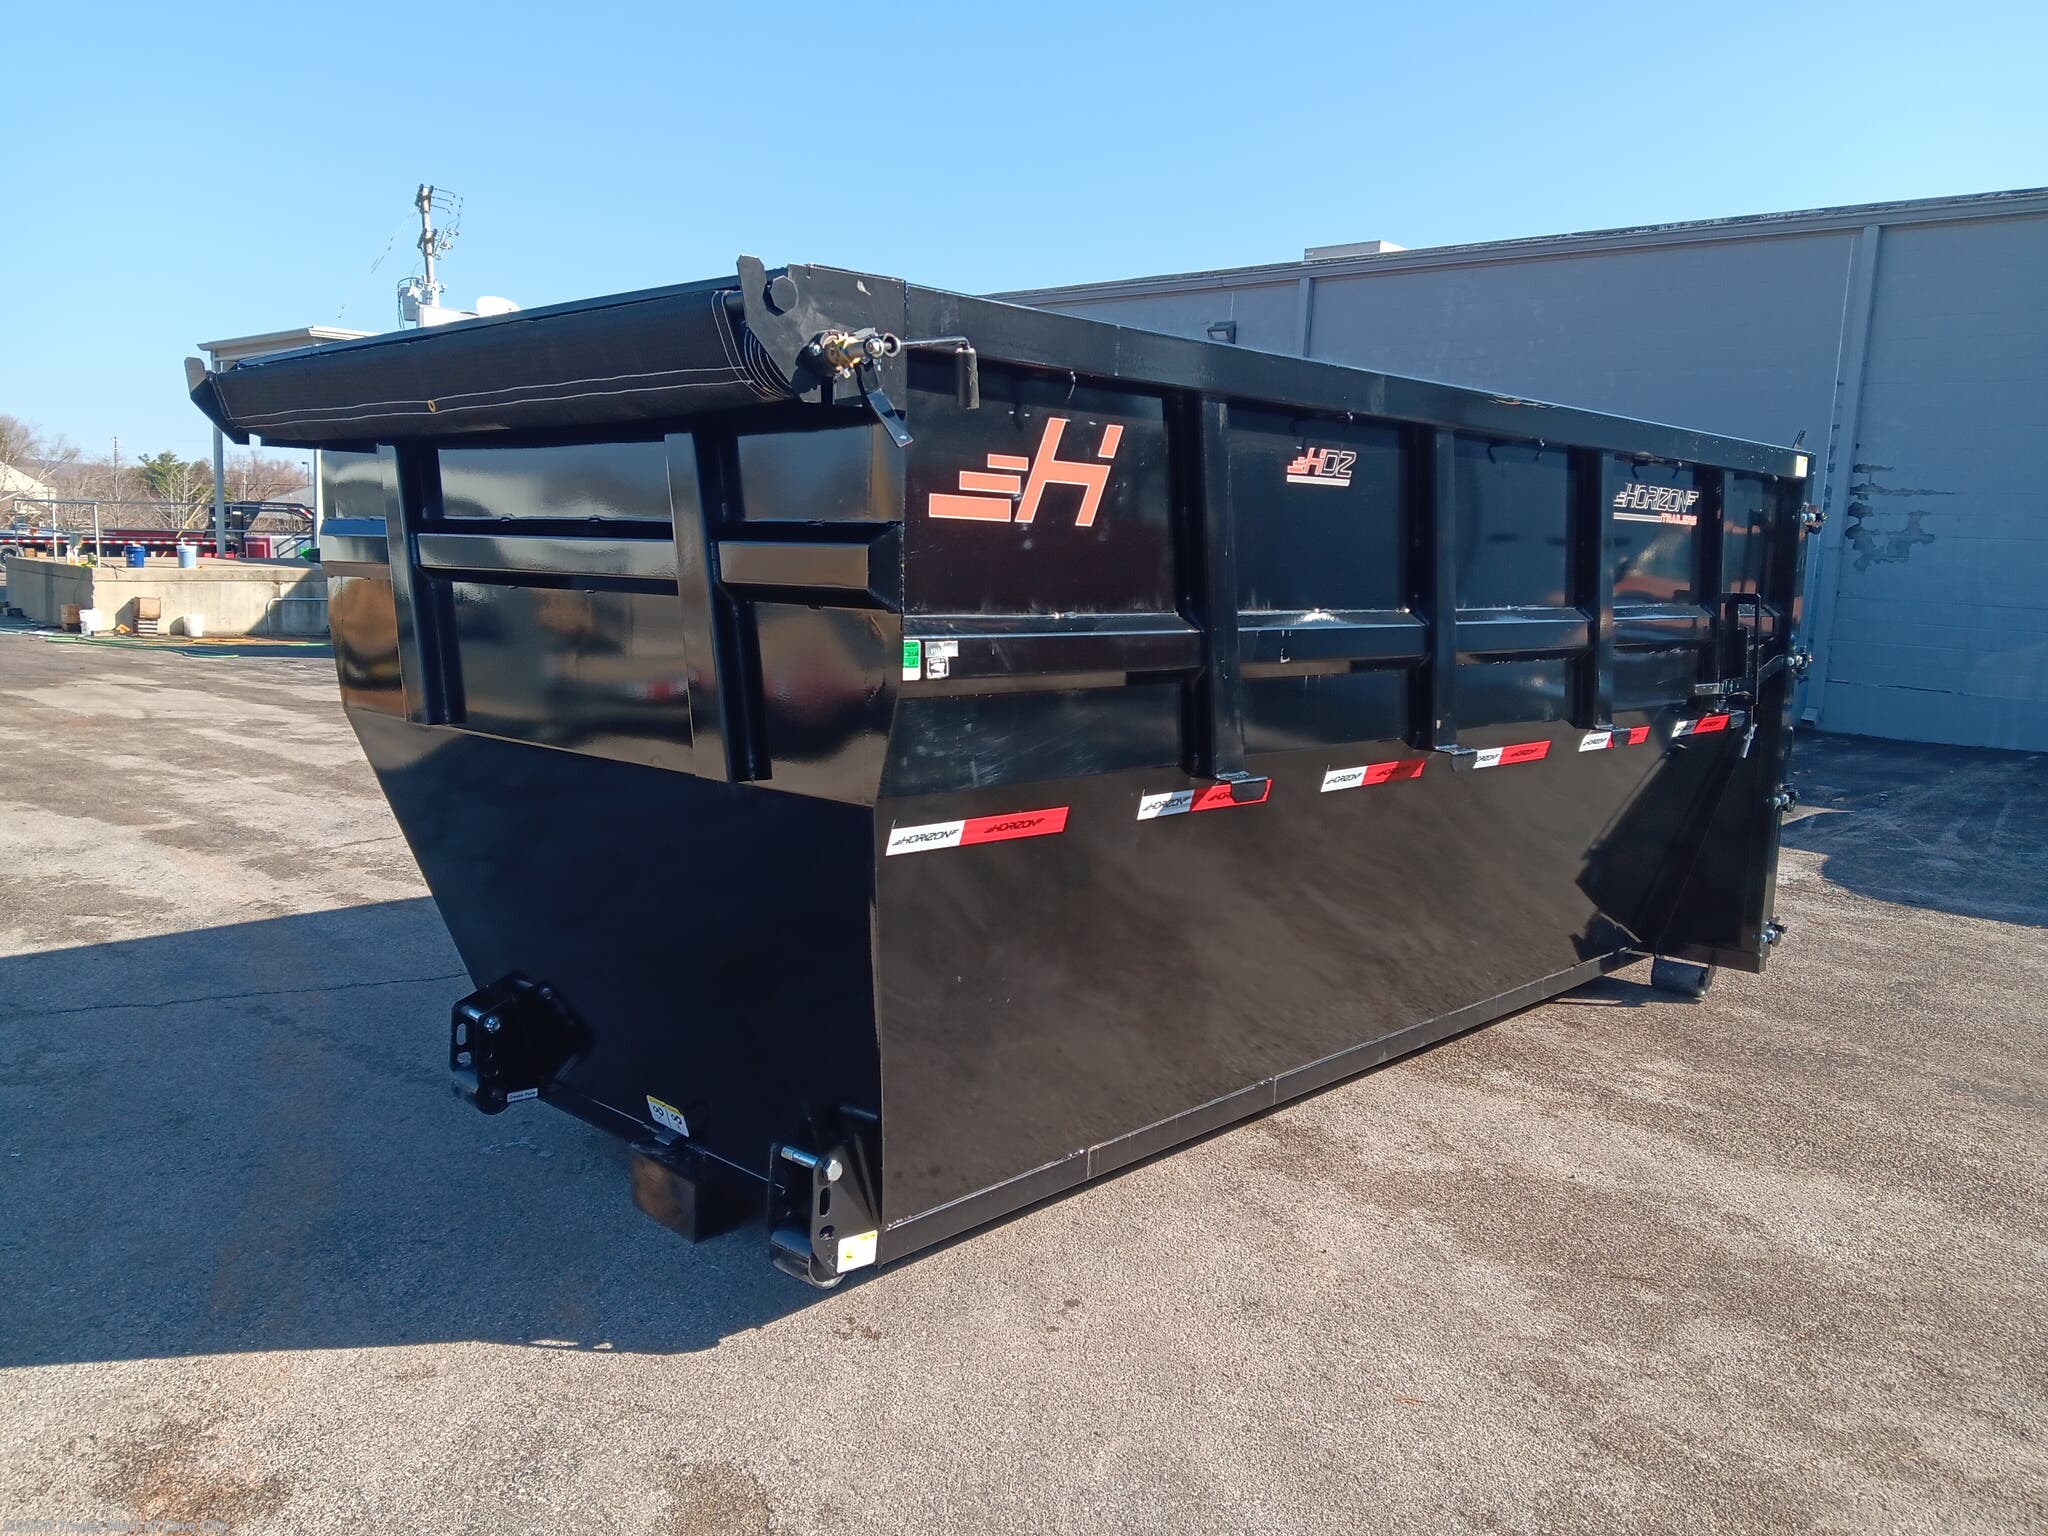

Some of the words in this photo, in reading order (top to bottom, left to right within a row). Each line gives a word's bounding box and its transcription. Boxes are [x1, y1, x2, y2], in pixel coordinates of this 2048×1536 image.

[1614, 483, 1699, 513] HORIZON
[1661, 513, 1698, 526] TRAILERS
[984, 818, 1045, 834] HORIZON
[892, 829, 960, 846] HORIZON
